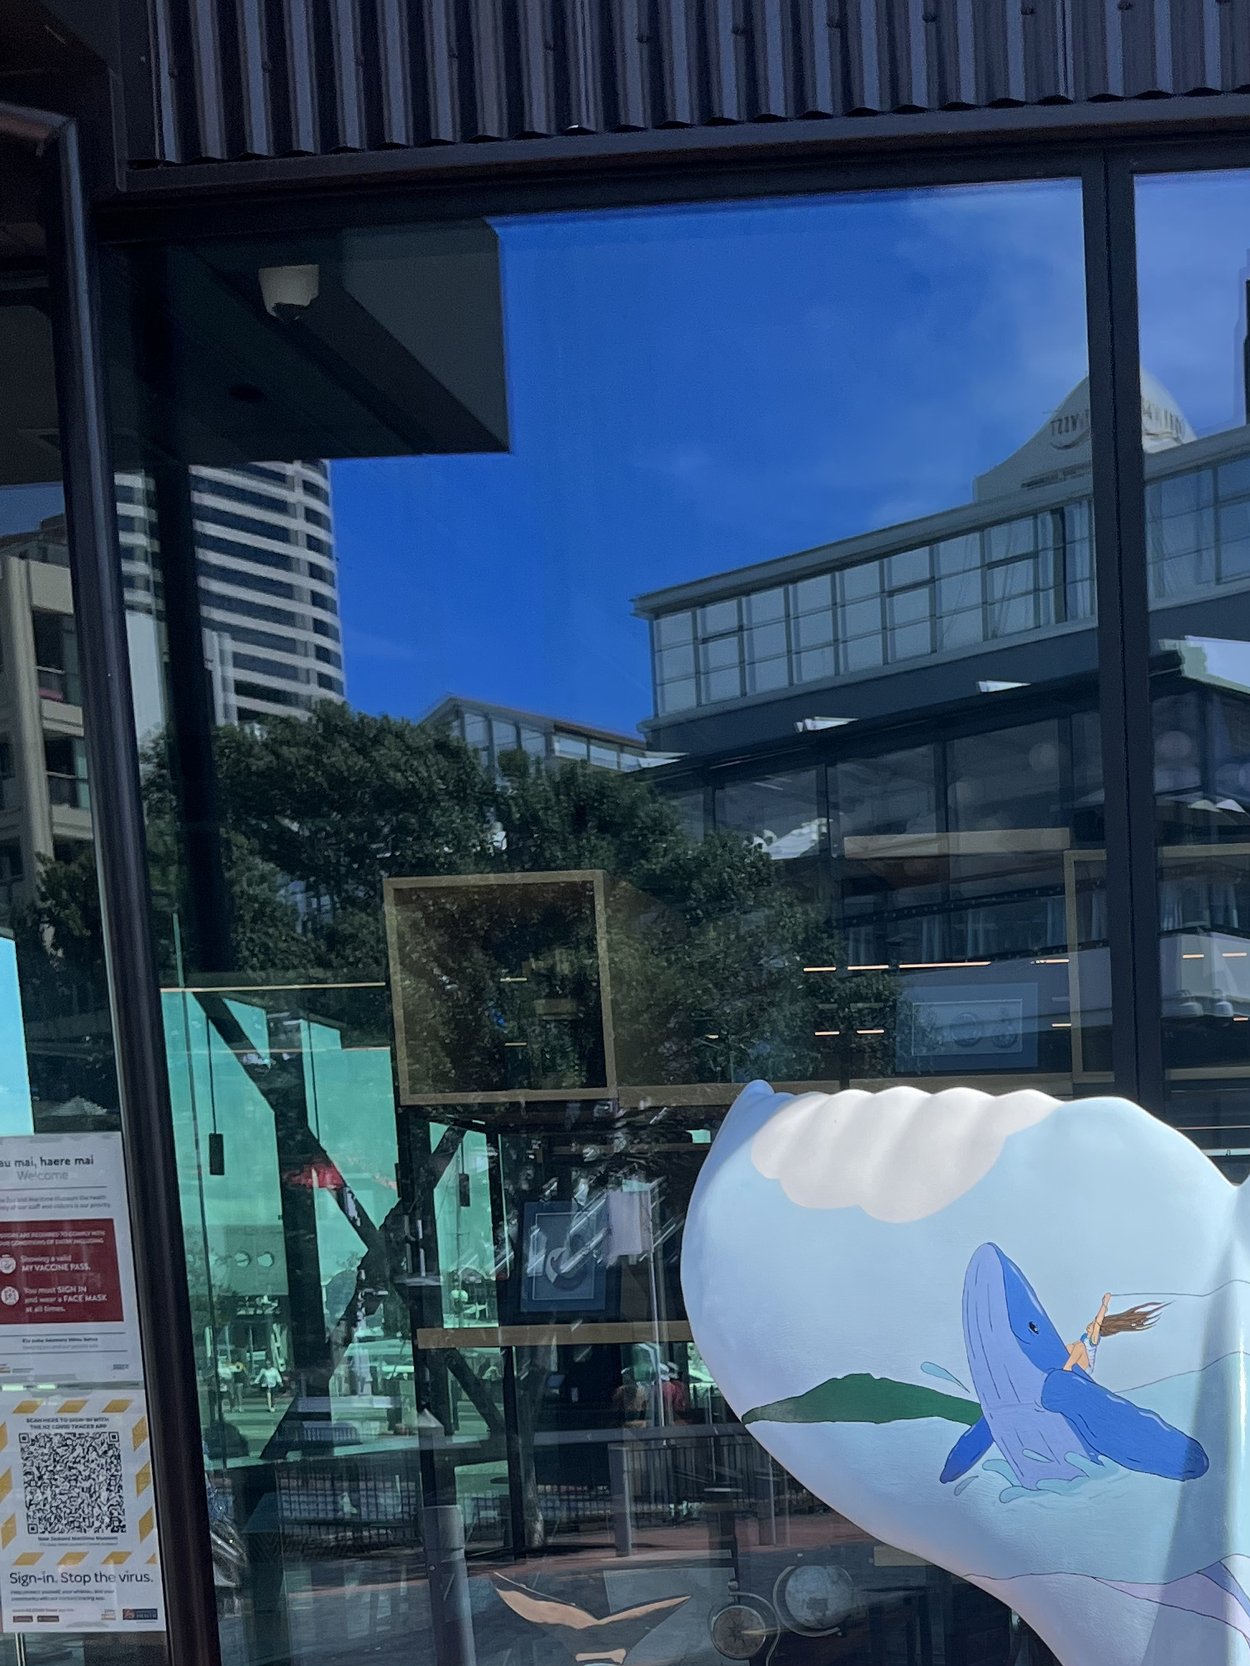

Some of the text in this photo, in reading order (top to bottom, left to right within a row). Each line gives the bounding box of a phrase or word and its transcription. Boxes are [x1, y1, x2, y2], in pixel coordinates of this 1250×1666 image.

[0, 1160, 11, 1168] au
[40, 1156, 71, 1167] haere
[74, 1154, 94, 1166] mai
[17, 1170, 69, 1181] Welcome
[35, 1263, 69, 1272] VACCINE
[63, 1294, 84, 1303] FACE
[85, 1293, 107, 1302] MASK
[9, 1570, 154, 1587] Sign-in. Stop the virus.
